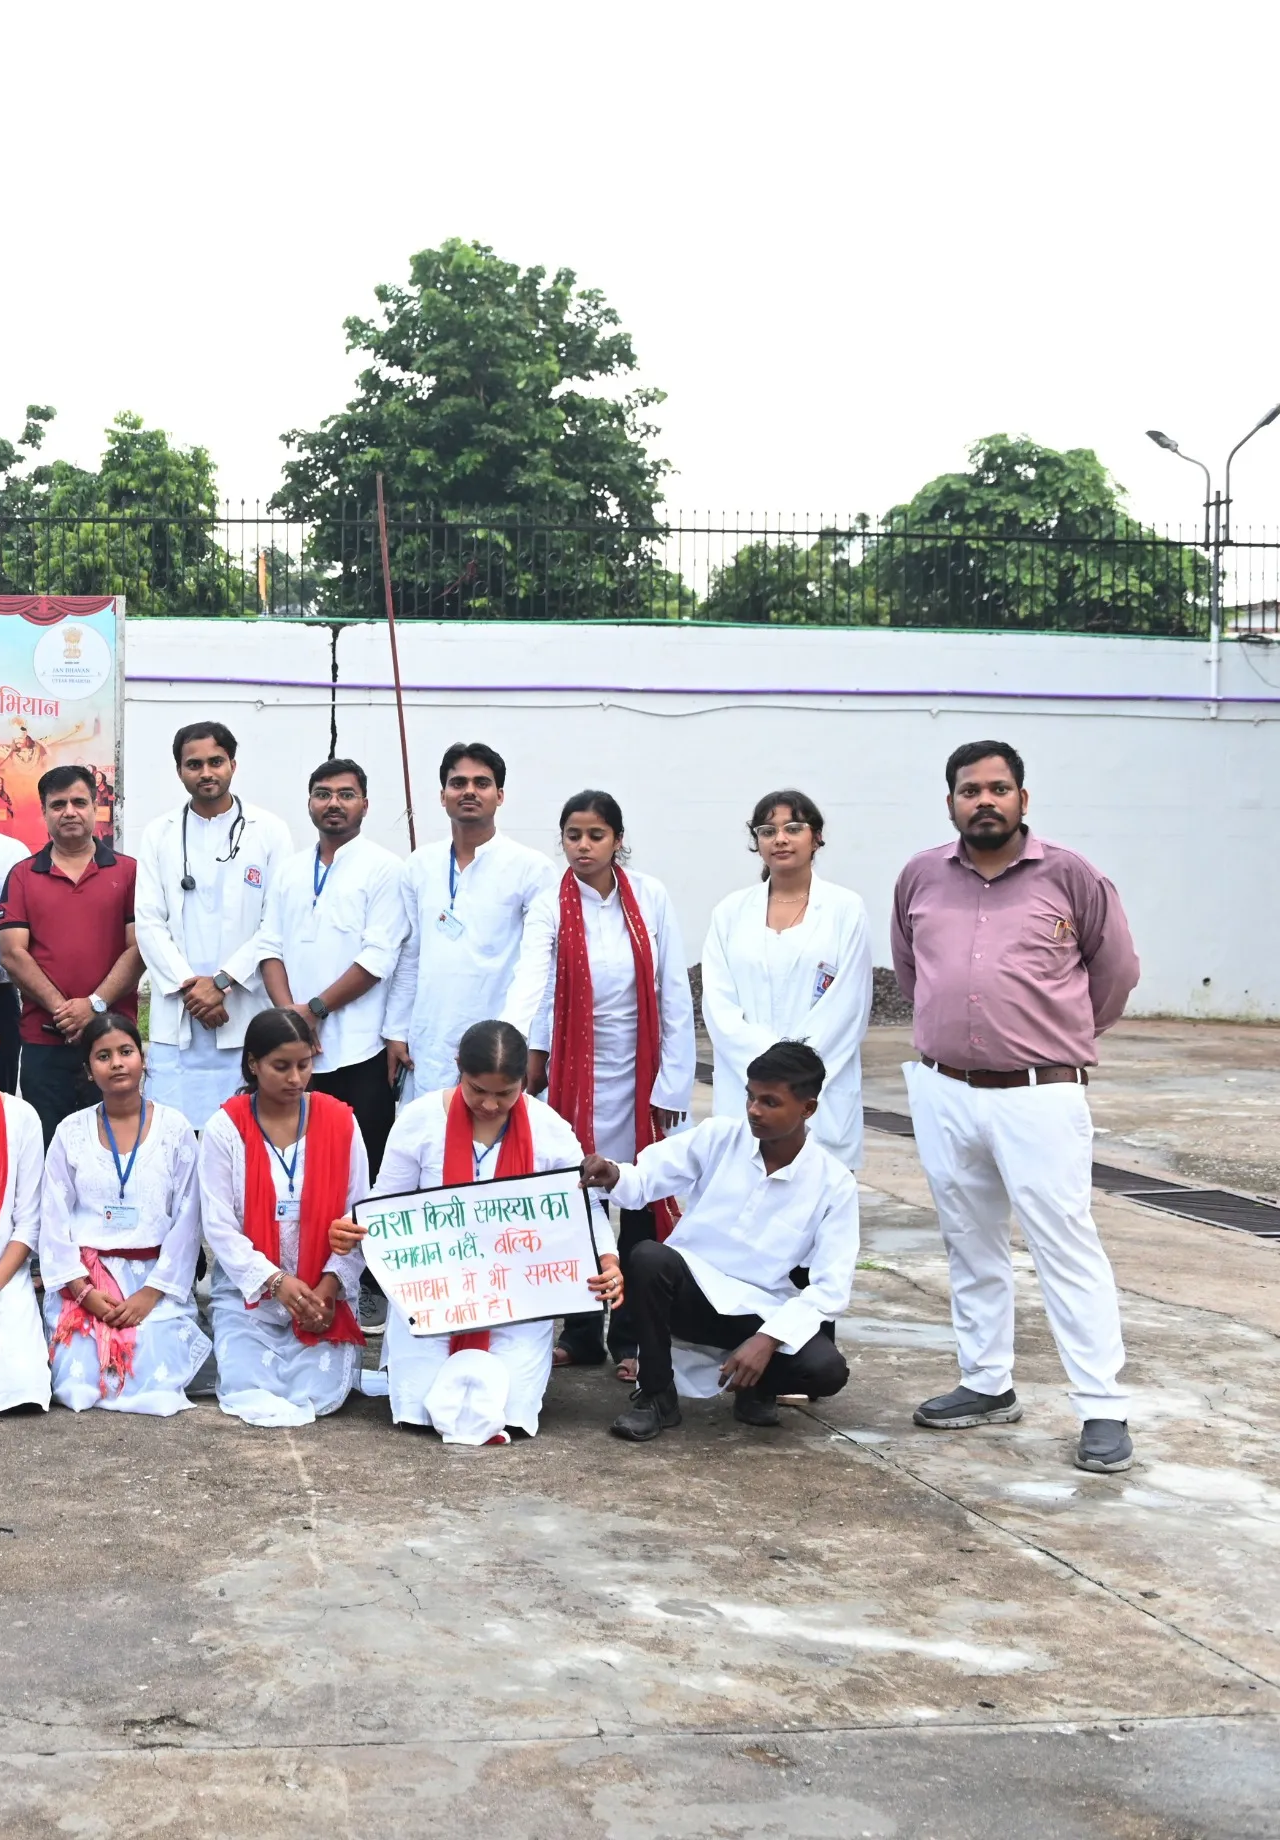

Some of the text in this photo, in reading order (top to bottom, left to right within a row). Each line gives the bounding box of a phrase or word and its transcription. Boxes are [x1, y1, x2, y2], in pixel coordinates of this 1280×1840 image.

[366, 1192, 569, 1239] नशा किसी समस्या का
[494, 1227, 542, 1254] बल्कि
[489, 1262, 511, 1290] भी
[523, 1259, 580, 1286] समस्या
